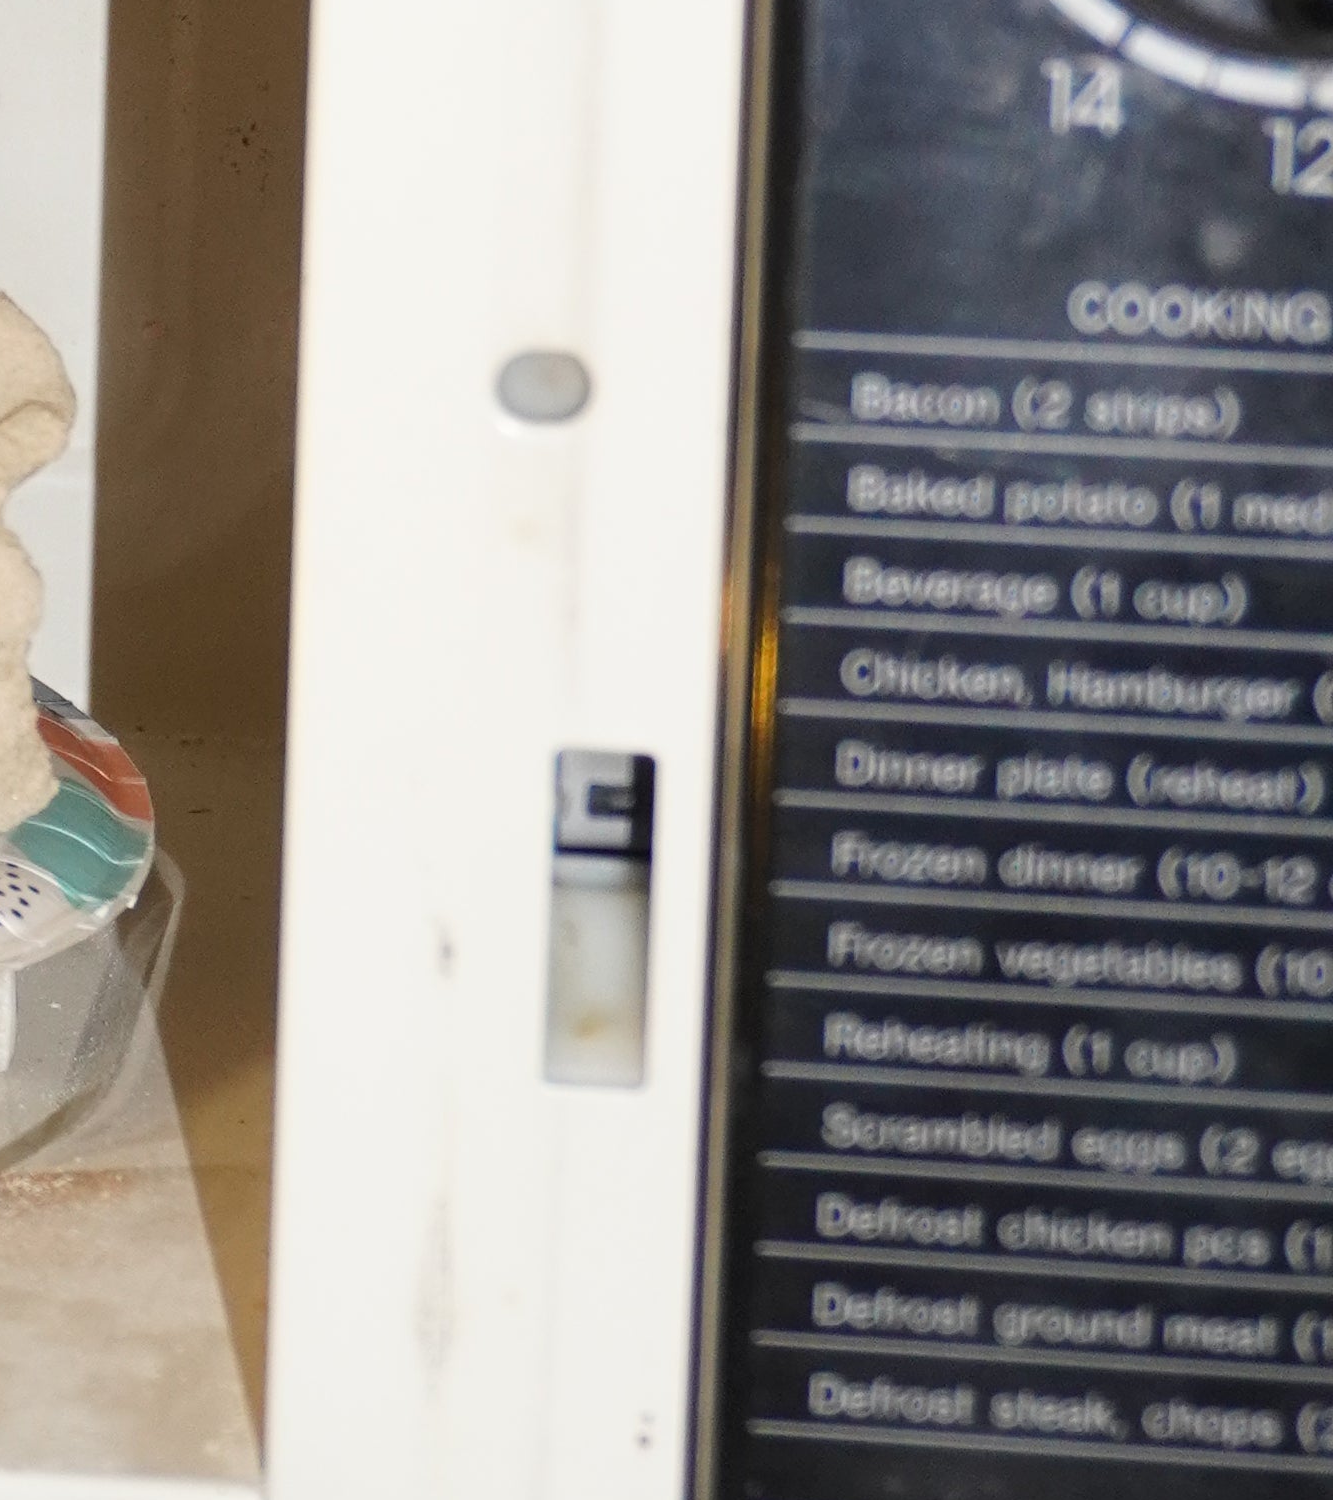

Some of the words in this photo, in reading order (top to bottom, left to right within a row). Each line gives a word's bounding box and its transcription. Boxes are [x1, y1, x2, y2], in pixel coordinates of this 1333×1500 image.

[1042, 55, 1124, 136] 14
[1067, 280, 1331, 344] COOKING
[850, 371, 1001, 424] Bacon
[1012, 375, 1073, 432] (2
[846, 463, 996, 519] Baked
[1003, 470, 1159, 527] potato
[842, 555, 1060, 620] Beverage
[1133, 570, 1249, 627] cup)
[1046, 656, 1300, 722] Hamburger
[834, 738, 987, 794] Dinner
[996, 750, 1114, 802] plate
[833, 830, 989, 885] Frozen
[998, 841, 1144, 892] dinner
[828, 920, 985, 971] Frozen
[995, 938, 1243, 990] vegetables
[823, 1011, 1051, 1079] Reheating
[1125, 1031, 1239, 1084] cup)
[822, 1101, 1064, 1162] Scrambled
[1071, 1124, 1187, 1176] eggs
[815, 1190, 987, 1242] Defrost
[997, 1207, 1175, 1259] chicken
[811, 1280, 980, 1336] Defrost
[993, 1300, 1154, 1348] ground
[1162, 1313, 1281, 1359] meat
[807, 1370, 976, 1425] Defrost
[1141, 1399, 1284, 1448] chops
